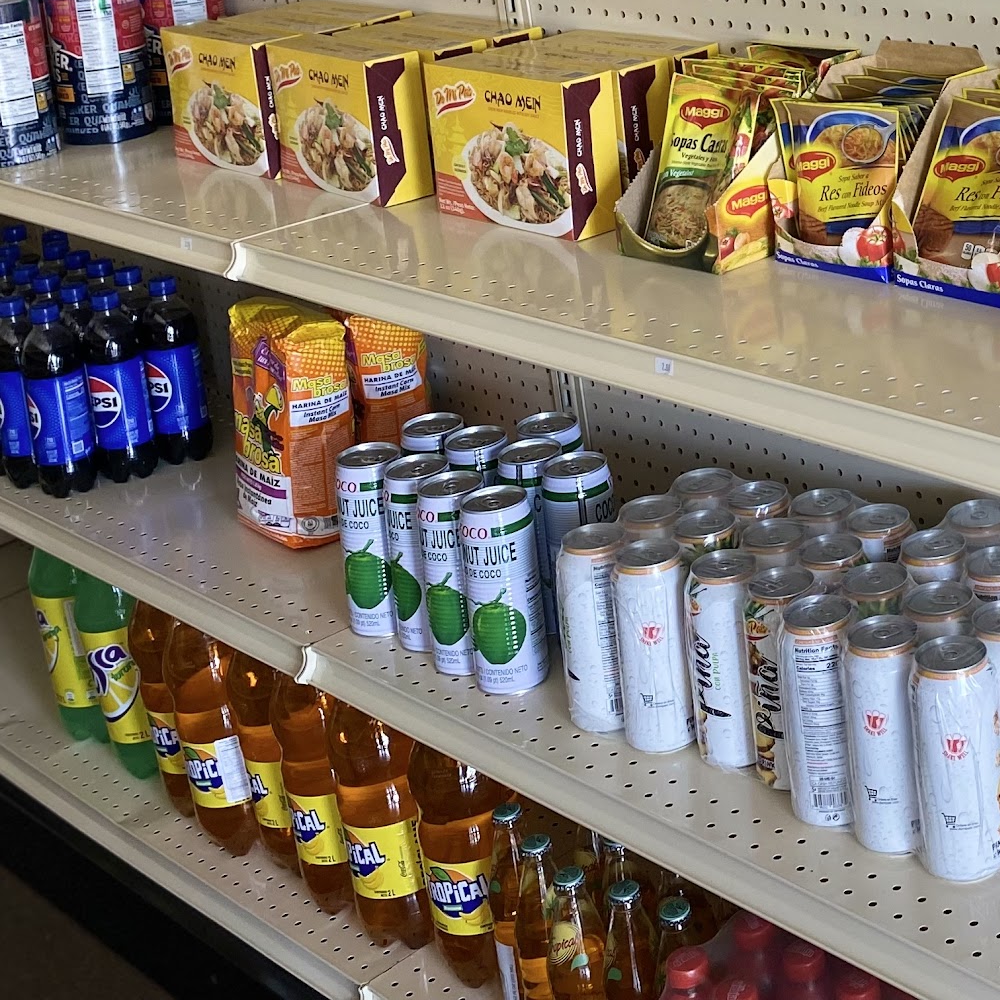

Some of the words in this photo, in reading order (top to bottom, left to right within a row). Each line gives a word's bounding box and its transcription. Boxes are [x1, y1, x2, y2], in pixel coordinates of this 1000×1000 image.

[198, 52, 216, 67] CHAO
[308, 68, 329, 84] CHAO
[331, 74, 349, 90] MEIN
[484, 89, 513, 107] CHAO
[515, 95, 541, 113] MEIN
[685, 106, 724, 119] Maggi
[820, 185, 841, 202] Res
[853, 180, 888, 198] Fideos
[954, 186, 982, 202] Res
[896, 273, 919, 287] Sopas
[919, 279, 944, 294] Claras
[361, 350, 402, 367] Masa
[291, 375, 333, 392] Masa
[364, 375, 392, 384] HARINA
[375, 383, 400, 392] Instant
[400, 377, 414, 387] Corn
[313, 380, 347, 397] brosa
[380, 389, 398, 398] Masa
[399, 384, 411, 393] Mix
[292, 400, 321, 409] HARINA
[303, 407, 328, 418] Instant
[308, 414, 327, 423] Masa
[243, 436, 281, 474] brosa
[249, 467, 258, 478] DE
[353, 496, 385, 518] JUICE
[349, 520, 369, 530] COCO
[431, 528, 461, 549] JUICE
[427, 552, 448, 562] COCO
[484, 541, 518, 566] JUICE
[469, 569, 478, 578] DE
[478, 568, 502, 579] COCO
[380, 610, 394, 619] NETO
[486, 667, 513, 677] CONTENIDO
[514, 664, 529, 674] NETO
